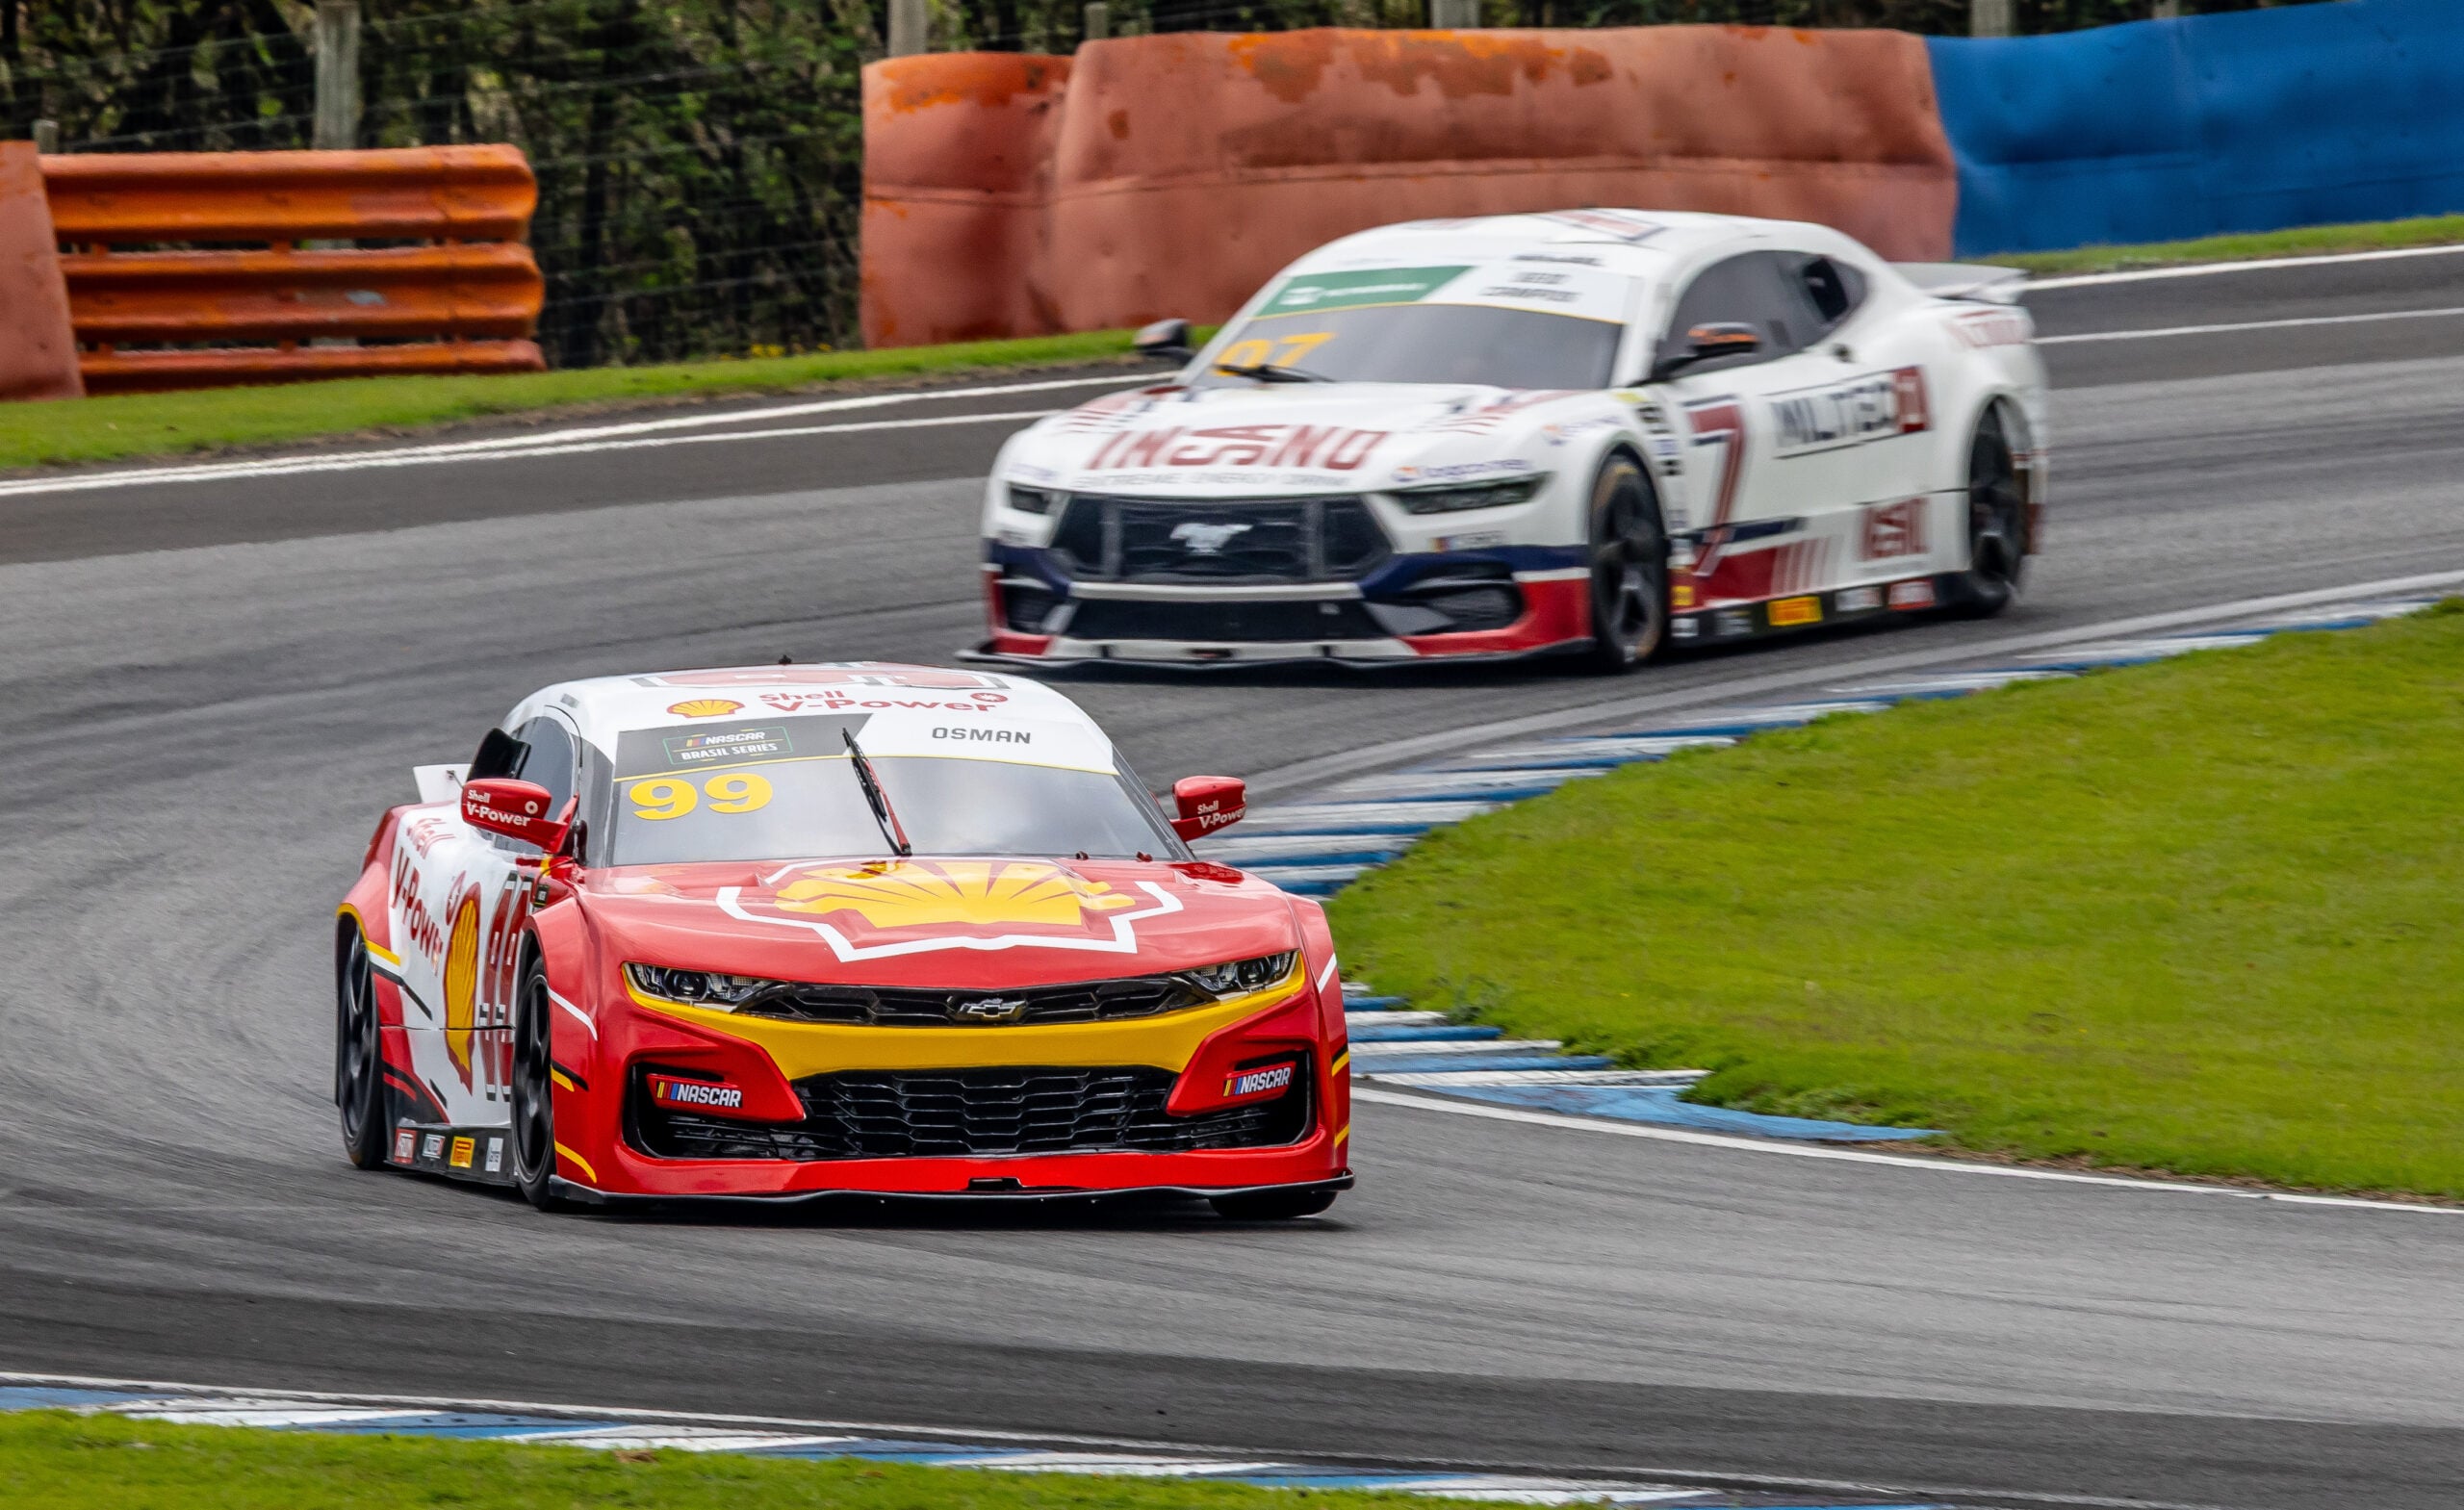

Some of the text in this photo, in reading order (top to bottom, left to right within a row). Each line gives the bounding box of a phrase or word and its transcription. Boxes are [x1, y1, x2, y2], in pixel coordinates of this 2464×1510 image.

[759, 690, 845, 702] Shell
[766, 699, 997, 712] V-Power
[705, 731, 766, 746] NASCAR
[932, 727, 1032, 744] OSMAN
[680, 742, 779, 761] BRASIL SERIES
[467, 789, 492, 805] Shell
[629, 773, 773, 820] 99
[466, 801, 531, 828] V-Power
[1197, 800, 1219, 815] Shell
[1240, 1066, 1292, 1094] NASCAR
[677, 1084, 743, 1108] NASCAR
